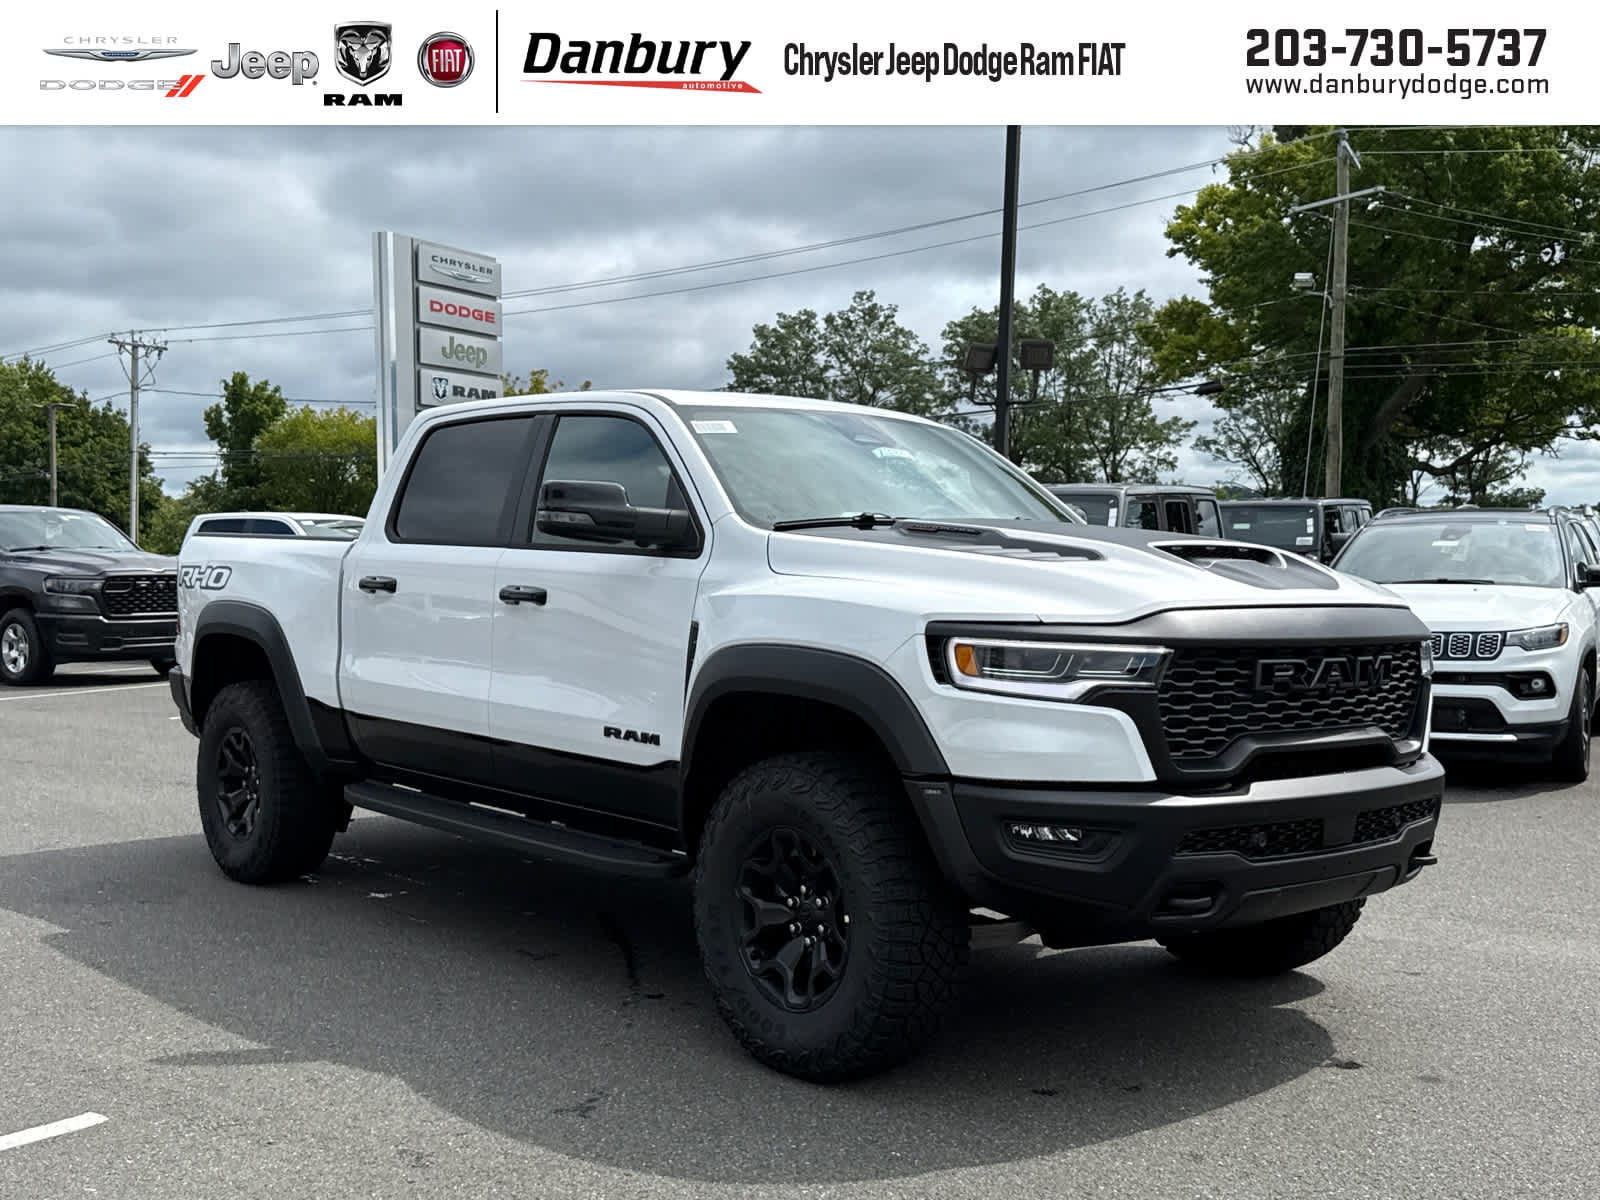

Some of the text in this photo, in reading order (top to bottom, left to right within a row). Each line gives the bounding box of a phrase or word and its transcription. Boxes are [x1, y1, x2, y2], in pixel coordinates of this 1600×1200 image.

[431, 255, 493, 275] CHRYSLER
[429, 299, 495, 323] DODGE
[441, 336, 488, 368] Jeep
[452, 385, 496, 399] RAM
[179, 564, 232, 590] RHO
[1256, 656, 1392, 689] RAM
[603, 726, 661, 746] RAM
